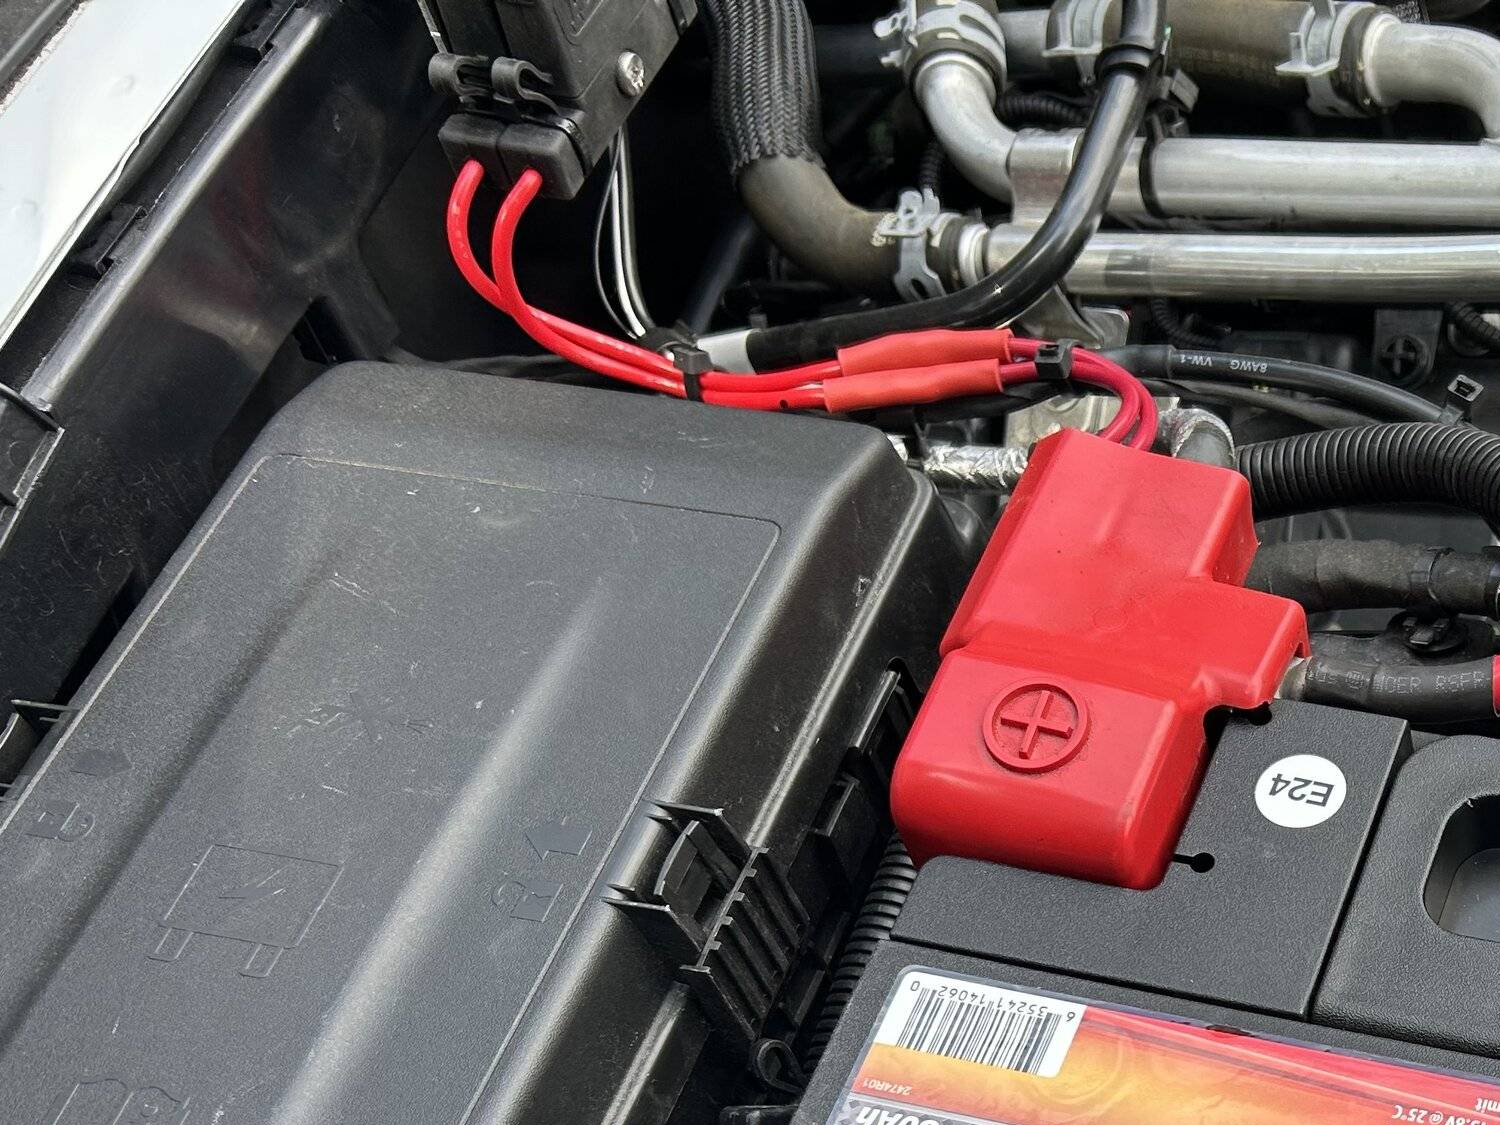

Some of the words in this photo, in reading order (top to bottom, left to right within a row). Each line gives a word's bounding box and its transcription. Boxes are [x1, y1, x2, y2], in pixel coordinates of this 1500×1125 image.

[1178, 353, 1212, 367] VW-1
[1229, 358, 1267, 372] 8AWG
[1268, 771, 1334, 806] E24
[908, 979, 920, 992] 0
[936, 984, 987, 1006] 14062
[995, 996, 1048, 1018] 35241
[1064, 1010, 1076, 1023] 6
[861, 1077, 911, 1095] 2474R01
[1390, 1103, 1427, 1123] 25°C
